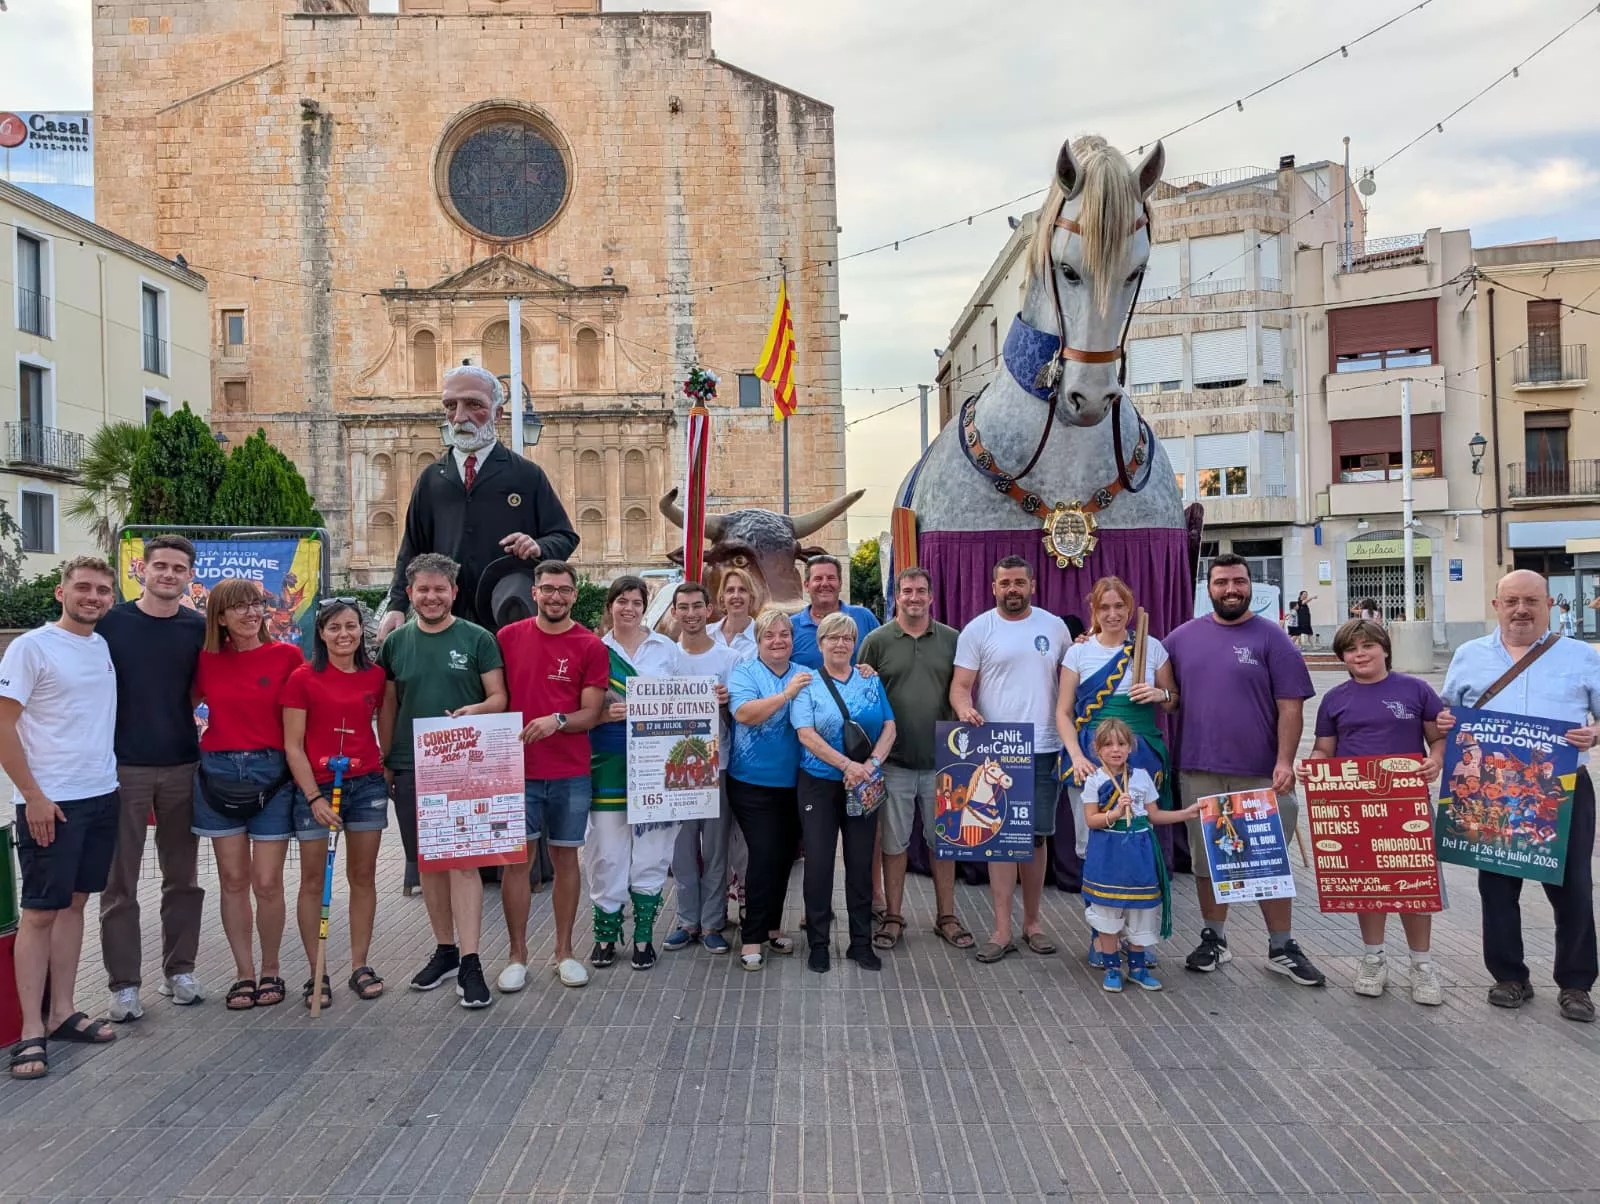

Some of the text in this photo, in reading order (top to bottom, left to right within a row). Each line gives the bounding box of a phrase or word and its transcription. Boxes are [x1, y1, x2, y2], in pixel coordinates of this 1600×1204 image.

[29, 114, 88, 134] Casal
[1353, 544, 1368, 555] la
[194, 557, 279, 570] NT JAUME
[196, 568, 264, 580] UDOMS
[636, 679, 709, 696] CELEBRACIÓ
[629, 701, 716, 717] BALLS DE GITANES
[1515, 721, 1550, 731] MAJOR
[423, 726, 475, 747] CORREFOC
[1460, 723, 1569, 747] SANT JAUME
[1474, 733, 1552, 753] RIUDOMS
[1306, 760, 1359, 782] ULÉ
[1308, 778, 1425, 792] BARRAQUES 2026
[642, 793, 664, 806] 165
[1012, 806, 1029, 819] 18
[1361, 803, 1388, 818] ROCH
[1414, 802, 1429, 816] PD
[1312, 821, 1360, 835] INTENSES
[1441, 837, 1457, 849] Del
[1459, 840, 1469, 851] 17
[1470, 843, 1479, 853] al
[1481, 844, 1493, 856] 26
[1494, 848, 1506, 858] de
[1507, 850, 1531, 864] juliol
[1533, 854, 1559, 869] 2026
[1317, 854, 1436, 869] AUXILI ESBARZERS
[1320, 877, 1381, 885] FESTA MAJOR
[1321, 884, 1393, 892] DE SANT JAUME
